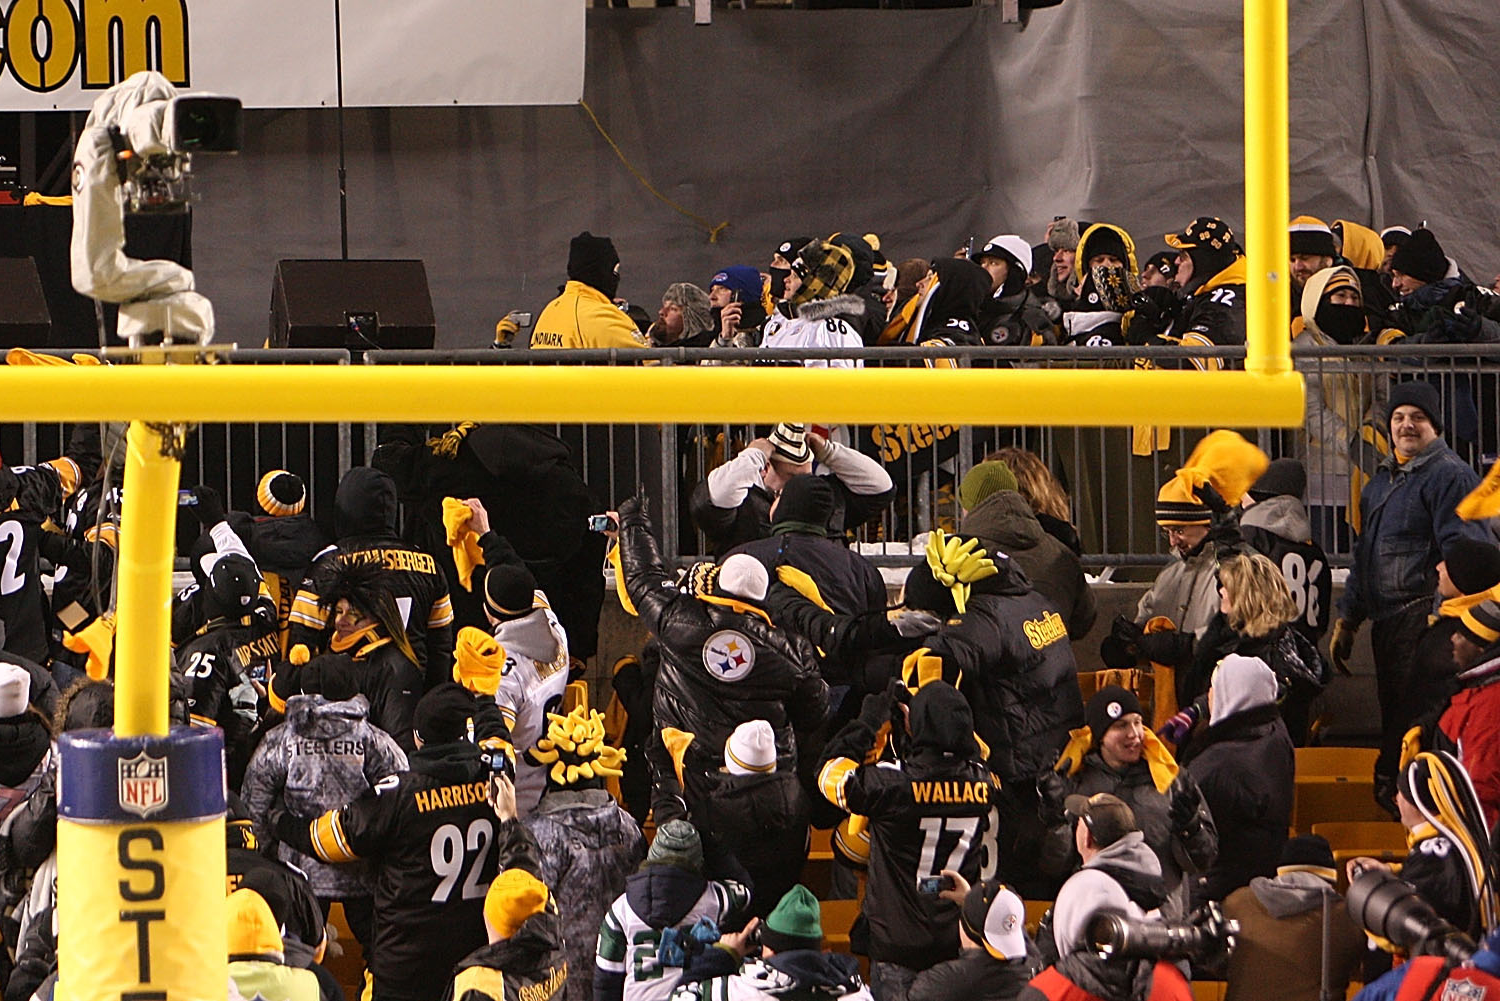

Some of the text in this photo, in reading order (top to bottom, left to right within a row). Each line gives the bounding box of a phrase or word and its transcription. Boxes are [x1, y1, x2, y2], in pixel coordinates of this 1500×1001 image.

[825, 317, 848, 334] 86
[184, 651, 216, 679] 25
[127, 782, 162, 806] NFL
[414, 781, 490, 814] HARRISO
[912, 780, 989, 805] WALLACE
[430, 818, 494, 904] 92
[916, 816, 981, 884] 17
